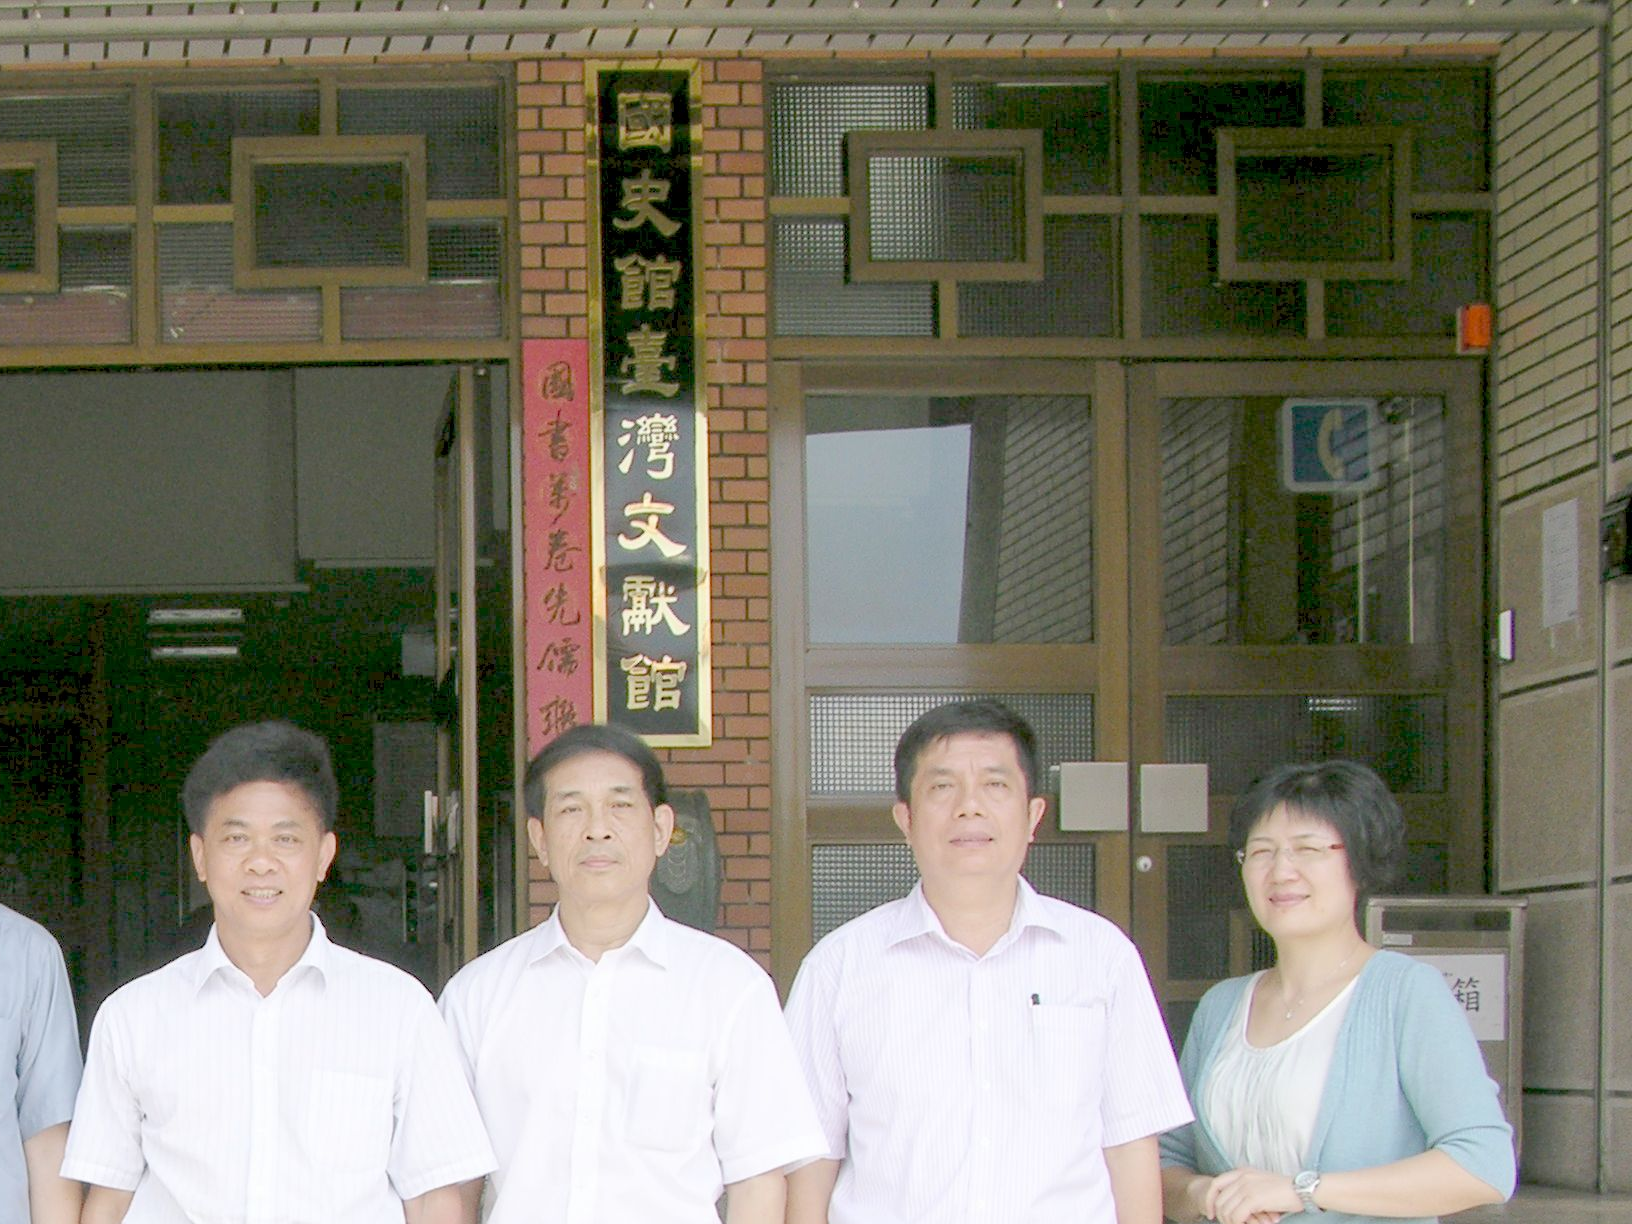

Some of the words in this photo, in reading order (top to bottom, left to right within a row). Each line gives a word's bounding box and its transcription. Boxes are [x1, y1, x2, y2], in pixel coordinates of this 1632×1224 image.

[612, 92, 690, 713] 國史館臺灣文獻館
